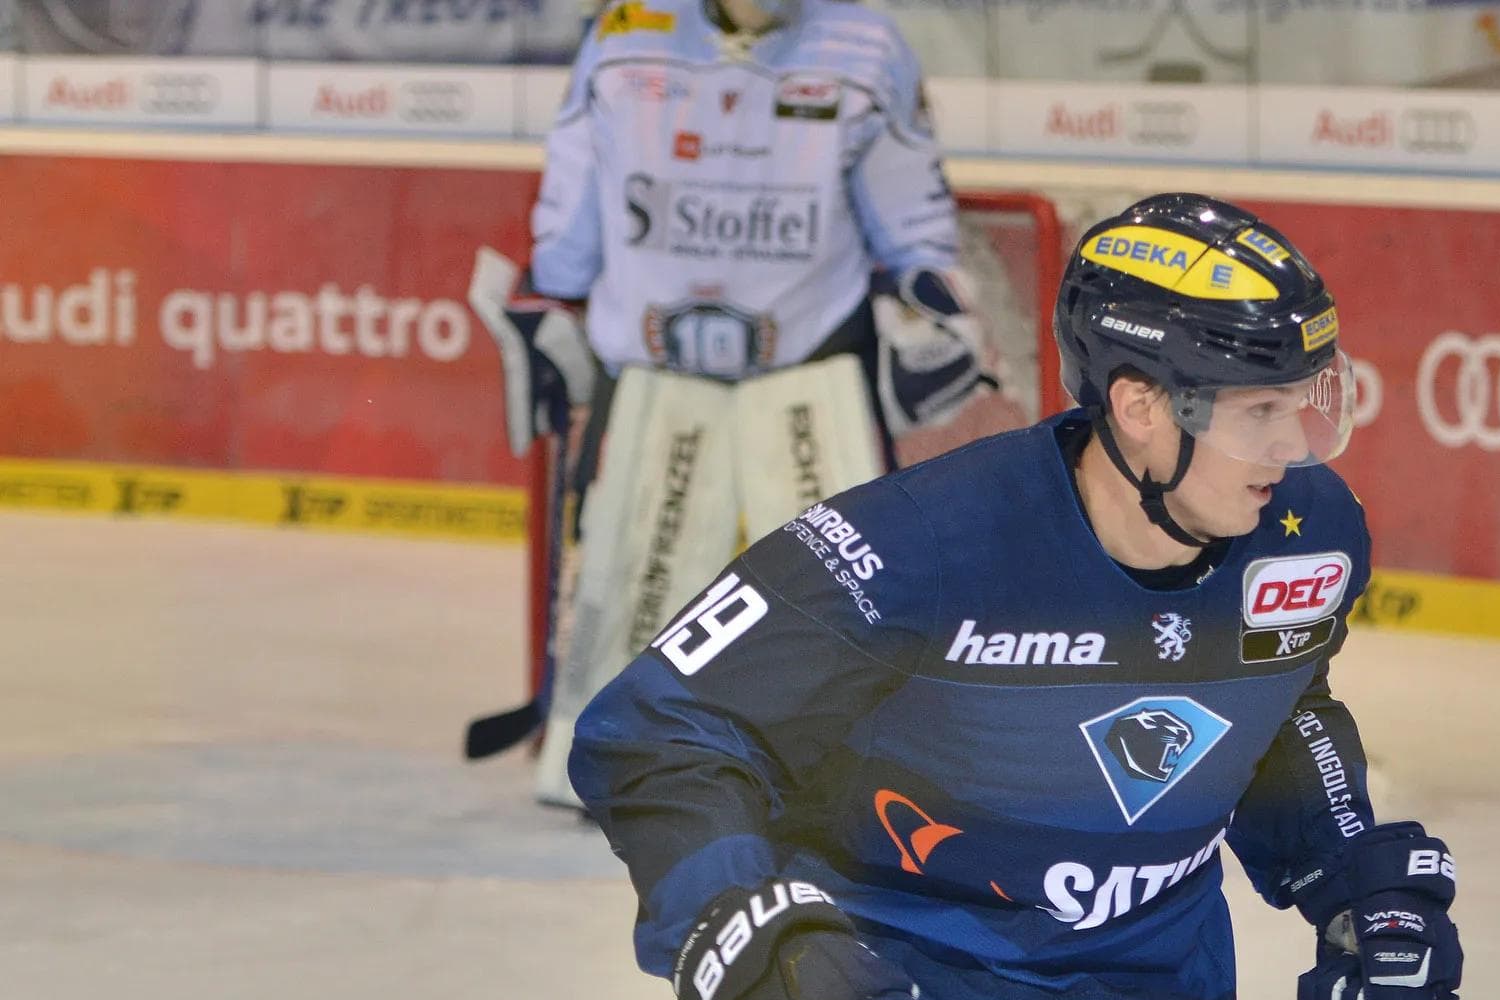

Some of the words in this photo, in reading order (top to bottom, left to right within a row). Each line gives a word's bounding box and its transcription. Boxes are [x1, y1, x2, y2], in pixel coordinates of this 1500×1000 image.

[1046, 105, 1120, 141] Audi
[1312, 111, 1392, 147] Audi
[675, 196, 818, 246] Stoffel
[1095, 236, 1188, 271] EDEKA
[0, 267, 137, 346] udi
[159, 285, 471, 369] quattro
[1101, 315, 1166, 342] BAUER
[834, 568, 882, 625] SPACE
[1251, 563, 1344, 615] DEL
[944, 619, 1107, 666] hama
